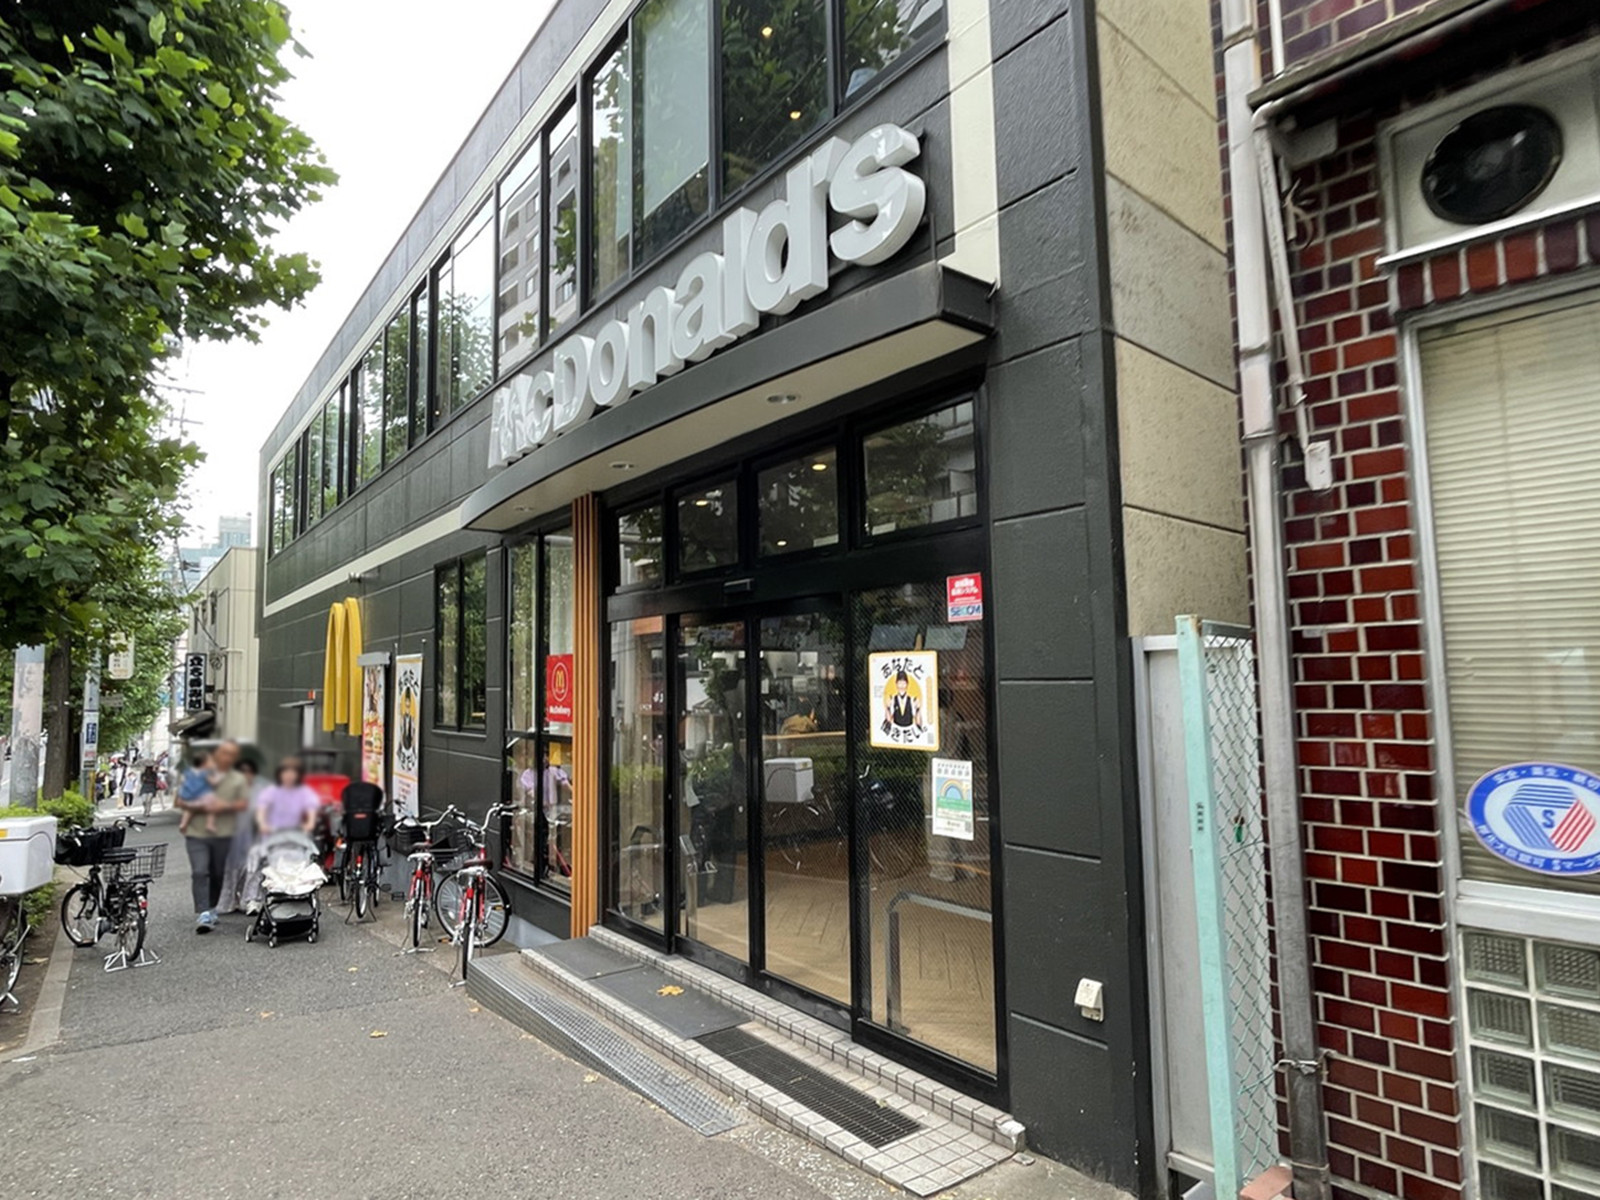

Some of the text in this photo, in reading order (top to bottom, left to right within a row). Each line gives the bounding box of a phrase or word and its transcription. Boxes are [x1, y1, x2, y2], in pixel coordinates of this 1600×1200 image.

[488, 123, 926, 469] McDonald's
[881, 657, 925, 680] あなたと
[1541, 809, 1556, 828] S
